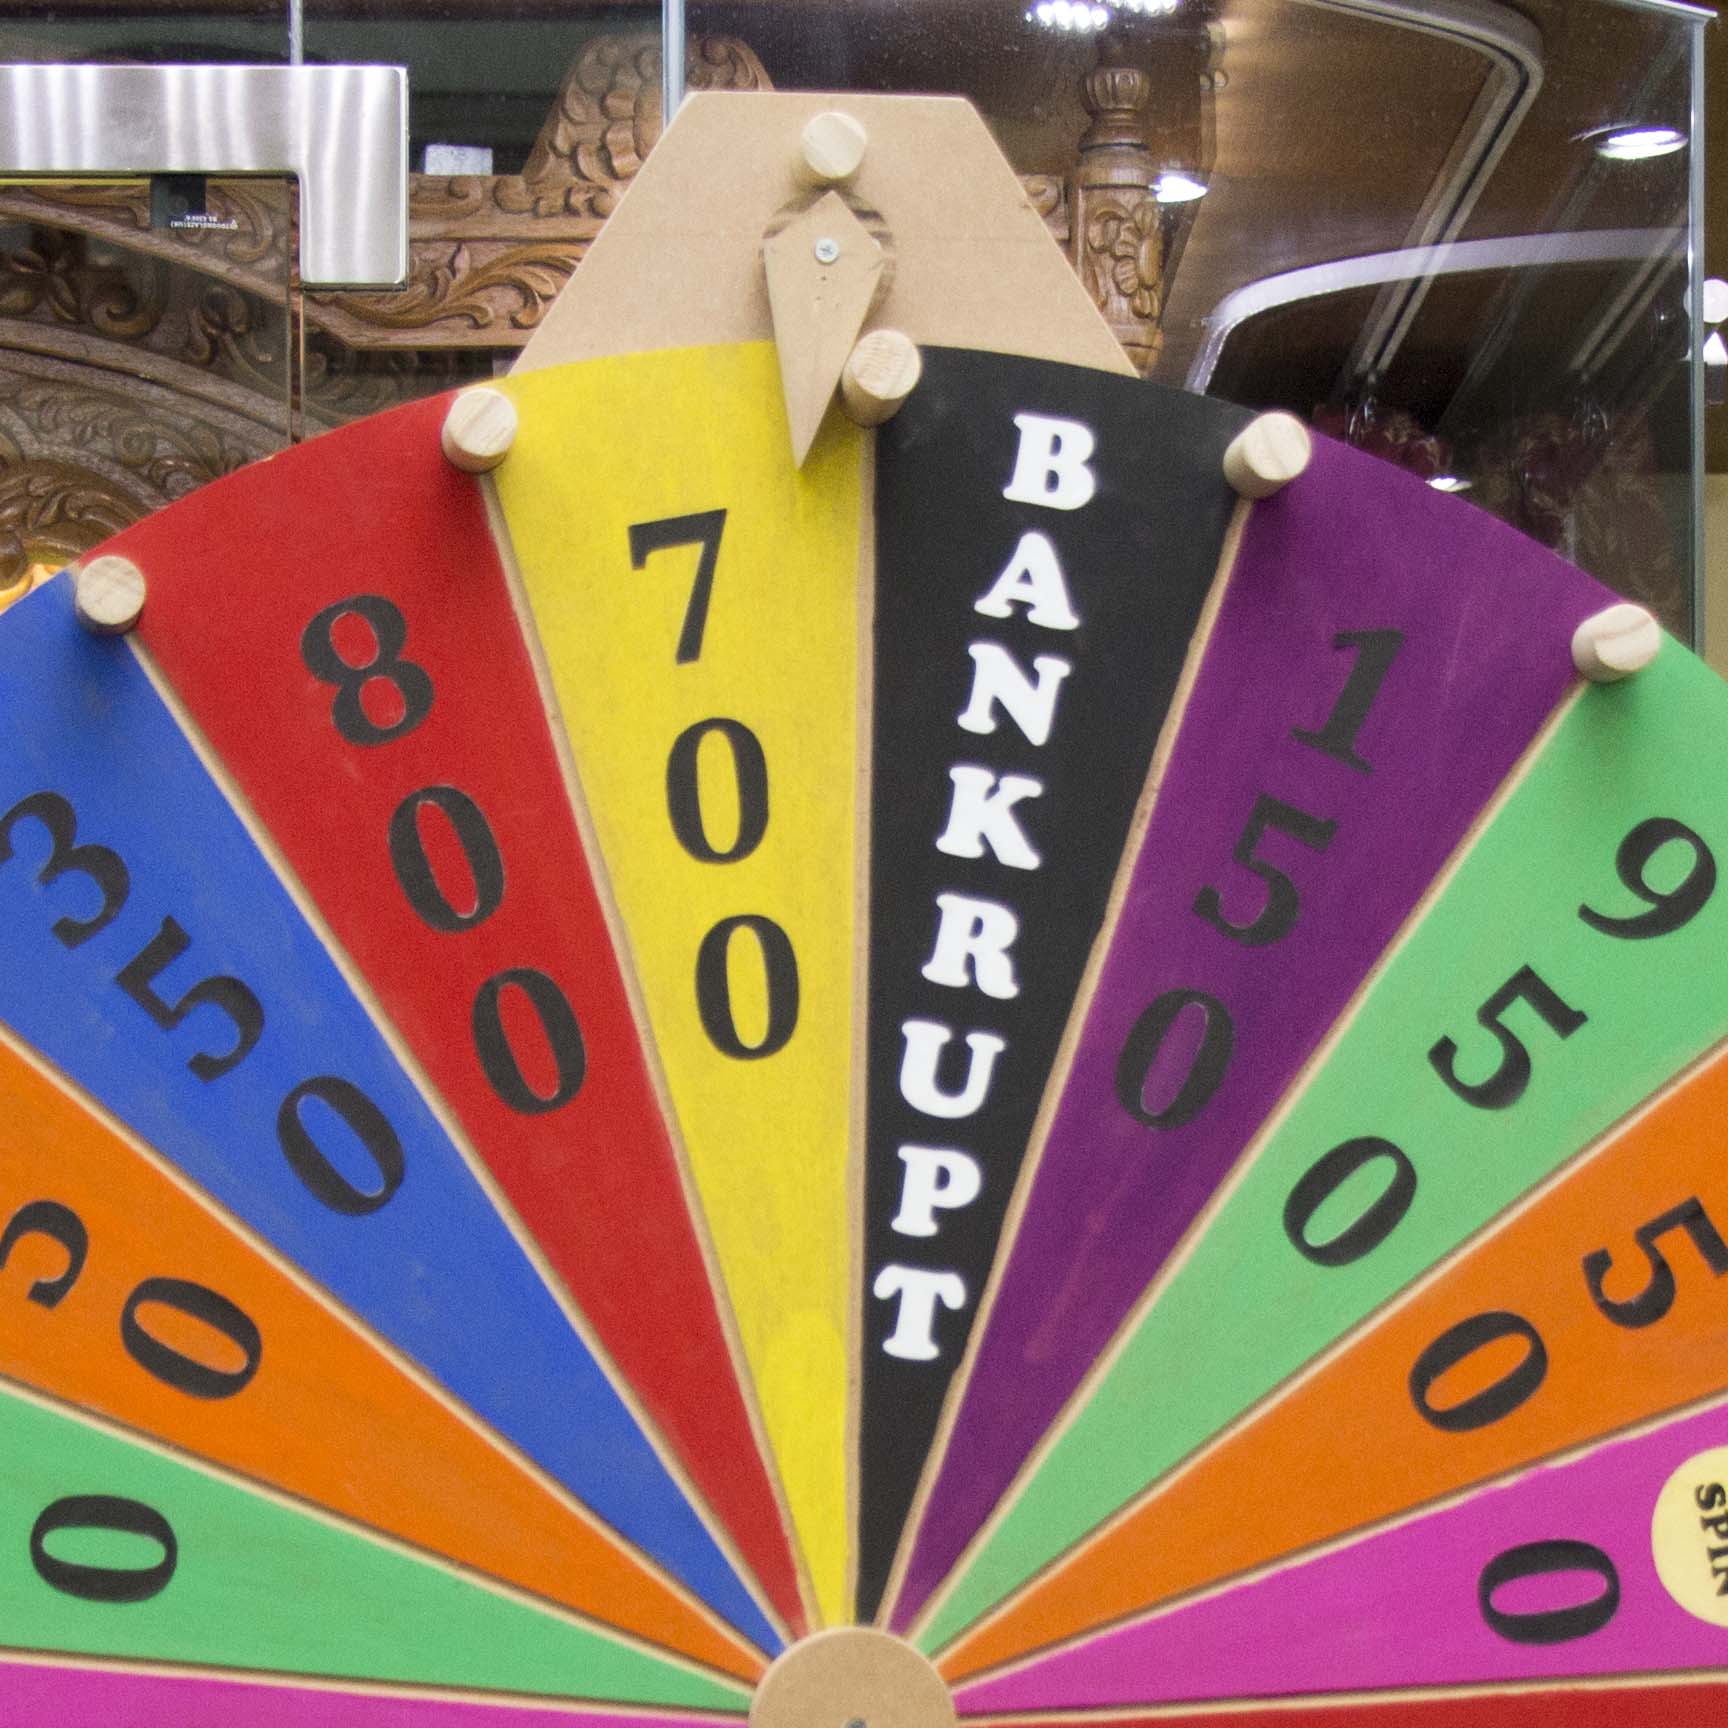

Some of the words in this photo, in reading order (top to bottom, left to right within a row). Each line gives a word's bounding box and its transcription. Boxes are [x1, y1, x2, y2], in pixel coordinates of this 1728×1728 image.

[299, 593, 588, 1117] 800
[628, 507, 801, 1061] 700
[873, 412, 1098, 1360] BANKRUPT
[1115, 628, 1406, 1130] 150
[1281, 816, 1719, 1267] 950
